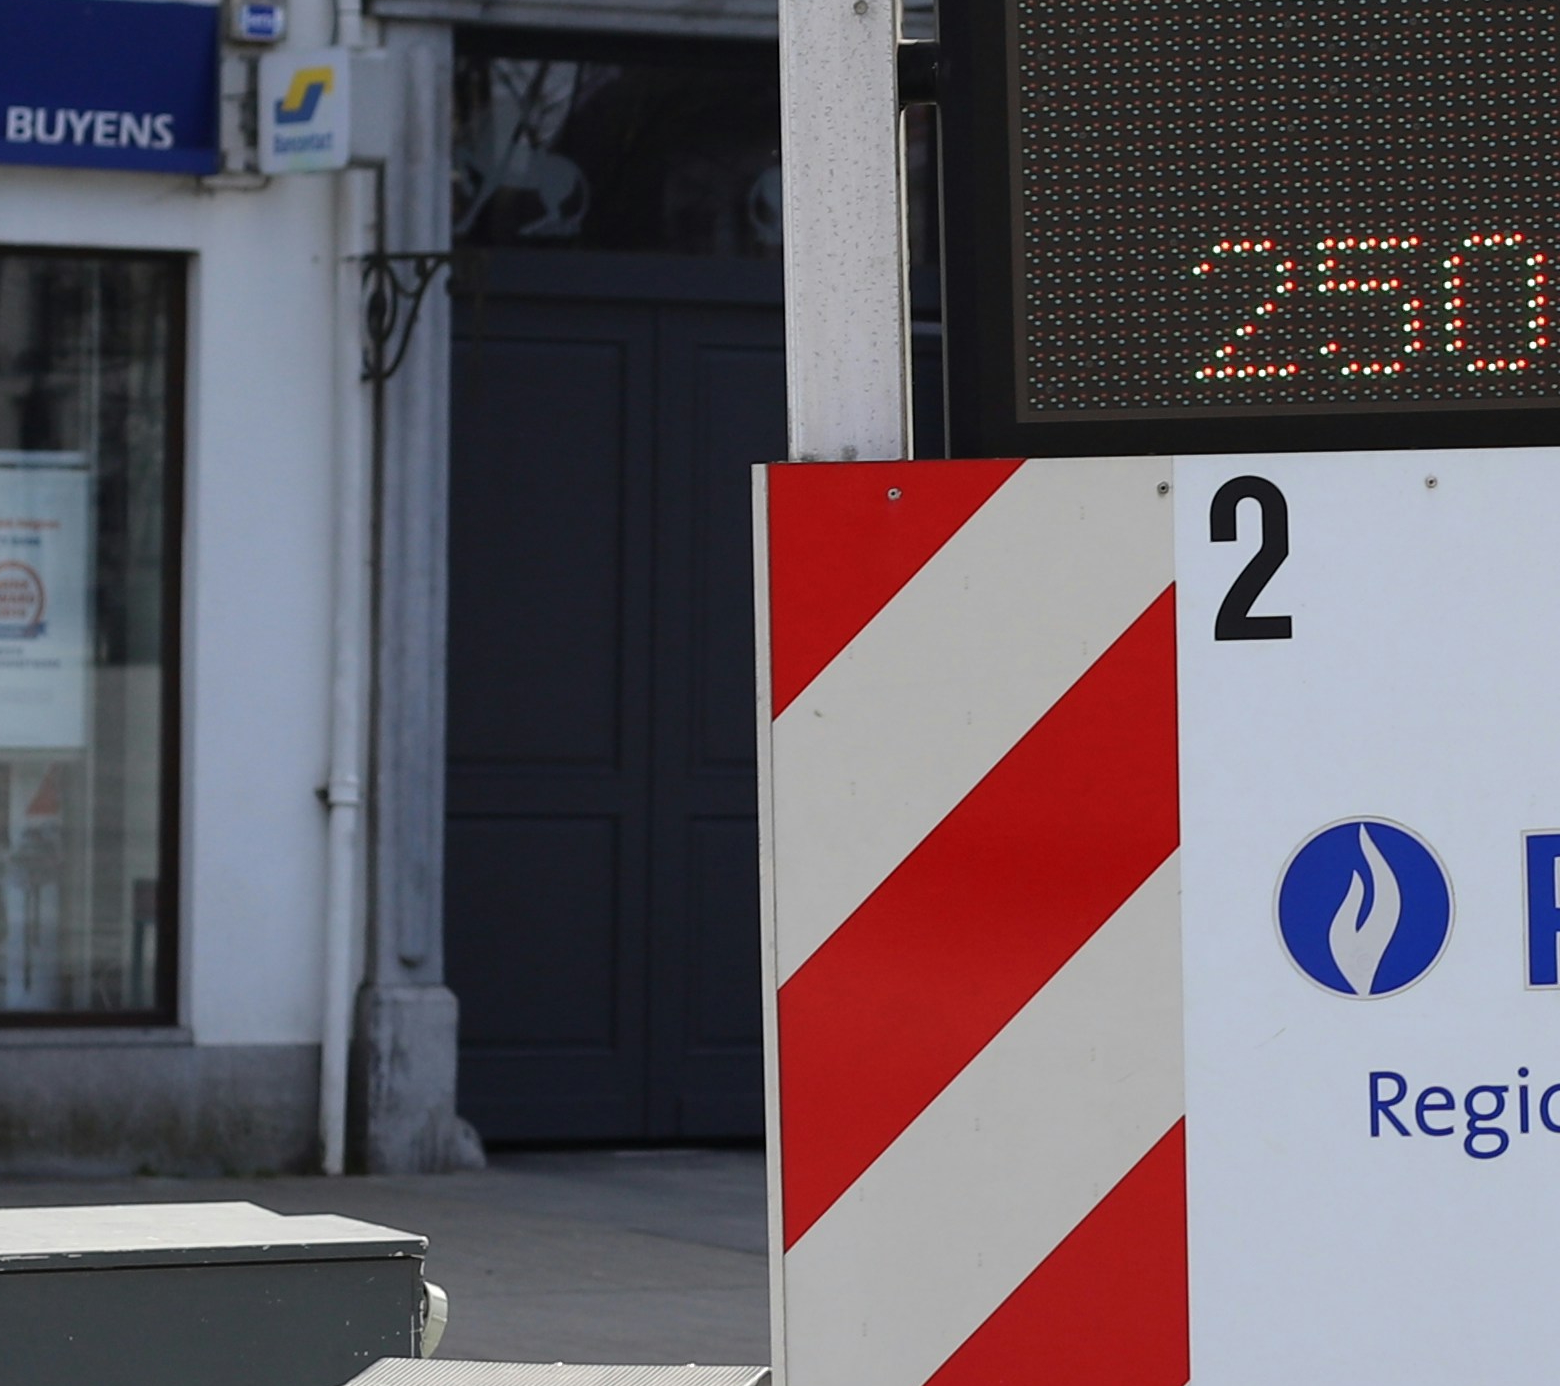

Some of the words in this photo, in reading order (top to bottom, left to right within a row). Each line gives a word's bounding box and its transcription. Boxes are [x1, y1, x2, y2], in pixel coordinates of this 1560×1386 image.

[6, 106, 173, 149] BUYENS
[1194, 232, 1550, 379] 250
[1209, 475, 1293, 642] 2
